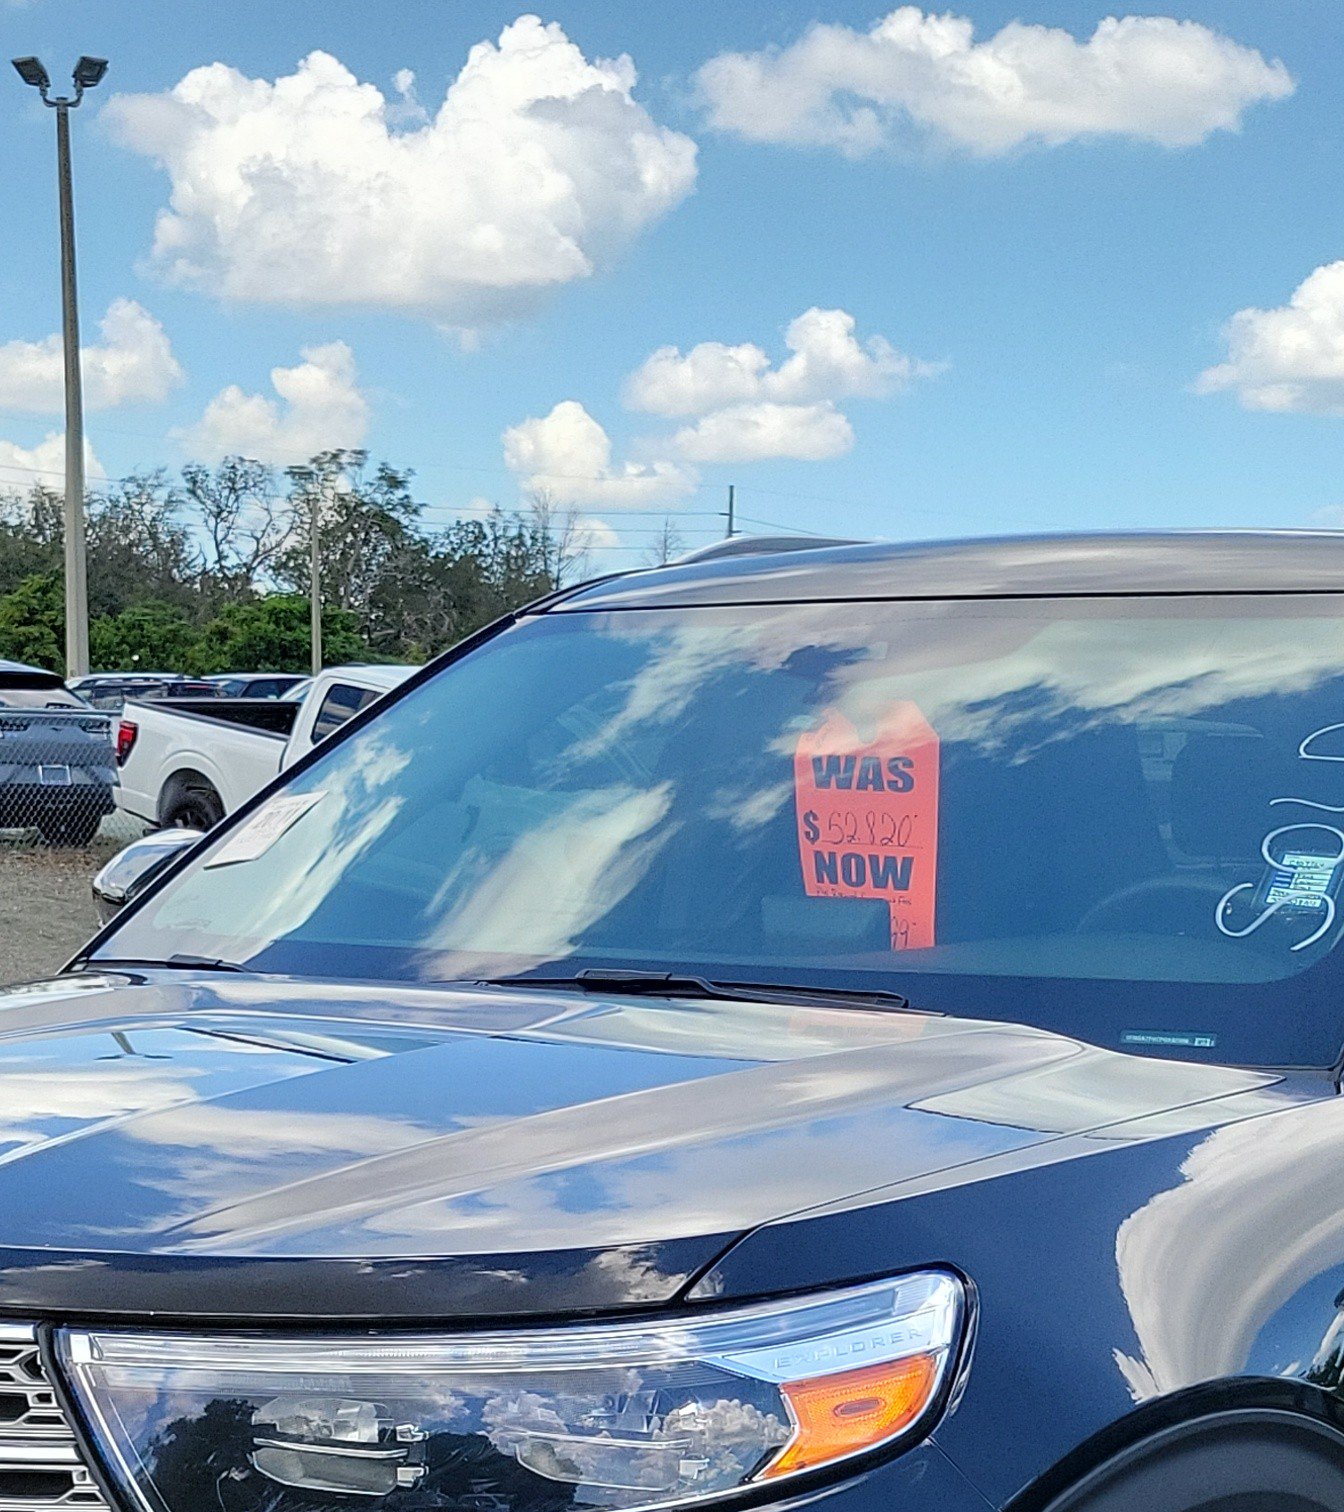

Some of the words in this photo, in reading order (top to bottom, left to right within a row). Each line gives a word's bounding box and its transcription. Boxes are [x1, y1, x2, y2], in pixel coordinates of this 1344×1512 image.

[812, 755, 915, 793] WAS
[813, 850, 914, 890] NOW
[774, 1329, 923, 1368] EXPLORER
